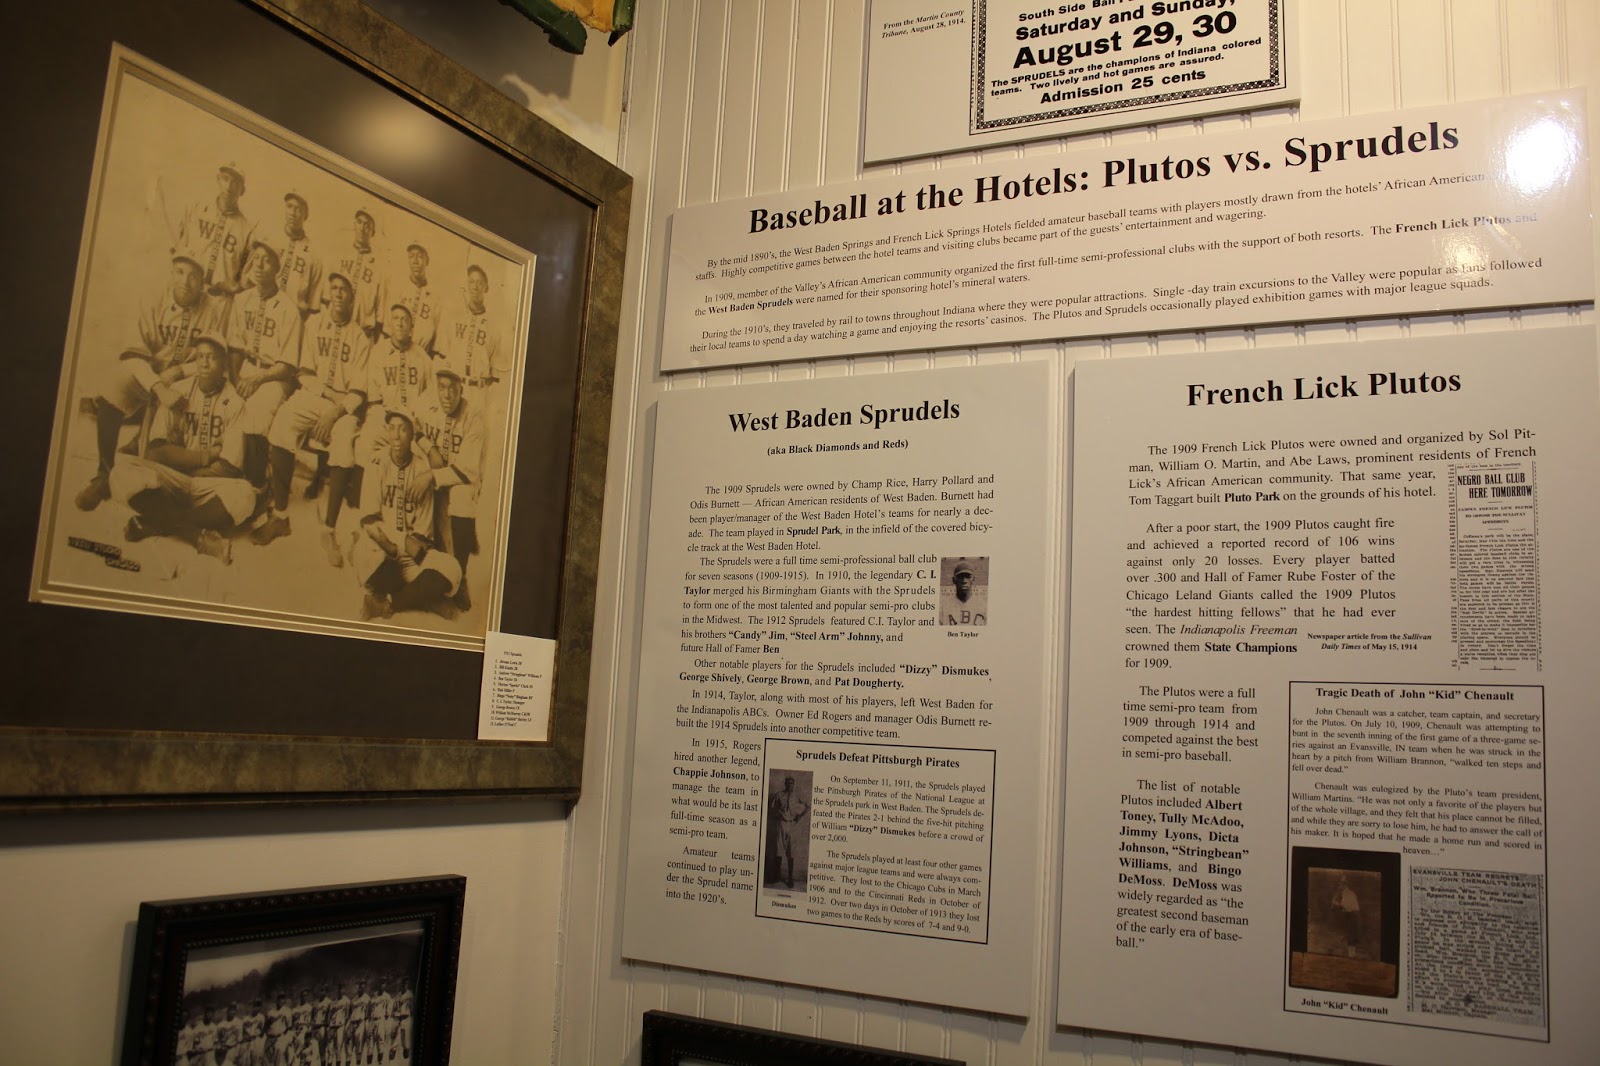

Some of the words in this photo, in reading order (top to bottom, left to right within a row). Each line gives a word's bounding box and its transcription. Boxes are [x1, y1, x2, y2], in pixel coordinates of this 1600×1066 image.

[883, 21, 902, 29] From
[915, 14, 938, 23] Martin
[940, 9, 964, 18] County
[1015, 15, 1102, 40] Saturday
[1108, 4, 1144, 24] and
[1018, 8, 1055, 22] South
[1058, 4, 1086, 14] Side
[881, 29, 908, 38] Tribune,
[910, 23, 934, 33] August
[948, 17, 965, 26] 1914.
[1012, 30, 1122, 69] August
[1132, 21, 1182, 48] 29,
[1192, 11, 1236, 38] 30
[990, 79, 1008, 87] The
[1010, 68, 1065, 84] SPRUDELS
[1086, 63, 1102, 71] the
[1105, 54, 1160, 68] champions
[1164, 50, 1174, 58] of
[1177, 45, 1221, 56] Indiana
[1222, 37, 1261, 50] colored
[990, 87, 1022, 96] teams.
[1029, 82, 1050, 90] Two
[1052, 76, 1079, 86] lively
[1082, 71, 1100, 81] and
[1103, 68, 1119, 78] hot
[1121, 64, 1155, 76] games
[1158, 61, 1175, 69] are
[1179, 52, 1224, 66] assured.
[1040, 83, 1123, 104] Admission
[1130, 75, 1154, 89] 25
[1161, 69, 1206, 84] cents
[749, 193, 866, 233] Baseball
[877, 190, 906, 215] at
[915, 183, 963, 210] the
[974, 167, 1088, 203] Hotels:
[1102, 155, 1210, 187] Plutos
[1222, 150, 1270, 173] vs.
[1284, 121, 1458, 172] Sprudels
[694, 308, 706, 316] the
[708, 305, 727, 314] West
[729, 302, 754, 312] Baden
[756, 297, 793, 310] Sprudels
[795, 296, 814, 304] were
[816, 291, 843, 302] named
[846, 290, 858, 299] for
[860, 287, 879, 297] their
[881, 283, 927, 297] sponsoring
[961, 275, 995, 287] mineral
[998, 274, 1030, 283] waters.
[1186, 379, 1283, 406] French
[1293, 375, 1359, 400] Lick
[1368, 371, 1461, 395] Plutos
[728, 412, 778, 432] West
[784, 407, 852, 429] Baden
[859, 398, 960, 429] Sprudels
[767, 446, 786, 456] (aka
[788, 444, 813, 453] Black
[815, 441, 860, 452] Diamonds
[862, 440, 879, 449] and
[882, 439, 908, 449] Reds)
[1457, 474, 1481, 486] NEGRO
[1484, 474, 1502, 484] BALL
[1506, 472, 1526, 484] CLUB
[1128, 495, 1151, 505] Tom
[1154, 494, 1193, 506] Taggart
[1196, 492, 1220, 503] built
[1224, 492, 1252, 502] Pluto
[1255, 491, 1280, 501] Park
[1299, 490, 1316, 500] the
[1320, 488, 1364, 502] grounds
[1368, 487, 1382, 498] of
[1383, 487, 1400, 497] his
[1403, 485, 1436, 497] hotel.
[1468, 487, 1488, 499] HERE
[1491, 485, 1532, 498] TOMORROW
[681, 629, 692, 637] his
[694, 629, 726, 638] brothers
[768, 630, 787, 640] Jim,
[846, 631, 883, 644] Johnny,
[885, 632, 903, 641] and
[1307, 632, 1345, 641] Newspaper
[1320, 642, 1339, 651] Daily
[1371, 643, 1386, 651] May
[1315, 687, 1348, 699] Tragic
[1351, 688, 1380, 697] Death
[1383, 688, 1395, 698] of
[1399, 689, 1425, 698] John
[1464, 690, 1514, 700] Chenault
[796, 749, 836, 761] Sprudels
[839, 752, 868, 762] Defeat
[872, 753, 922, 767] Pittsburgh
[925, 757, 959, 768] Pirates
[672, 767, 708, 779] Chappie
[710, 769, 748, 781] Johnson,
[750, 773, 758, 781] to
[1122, 810, 1156, 824] Toney,
[1158, 812, 1188, 826] Tully
[1191, 814, 1244, 828] McAdoo,
[821, 821, 847, 830] William
[880, 826, 915, 836] Dismukes
[918, 829, 941, 838] before
[950, 833, 973, 841] crowd
[975, 834, 984, 842] of
[1119, 825, 1158, 840] Jimmy
[1164, 828, 1201, 841] Lyons,
[1208, 831, 1238, 843] Dicta
[1118, 841, 1168, 856] Johnson,
[1118, 872, 1165, 886] DeMoss.
[1172, 877, 1217, 890] DeMoss
[1220, 883, 1242, 892] was
[1300, 998, 1321, 1007] John
[1350, 1003, 1388, 1014] Chenault
